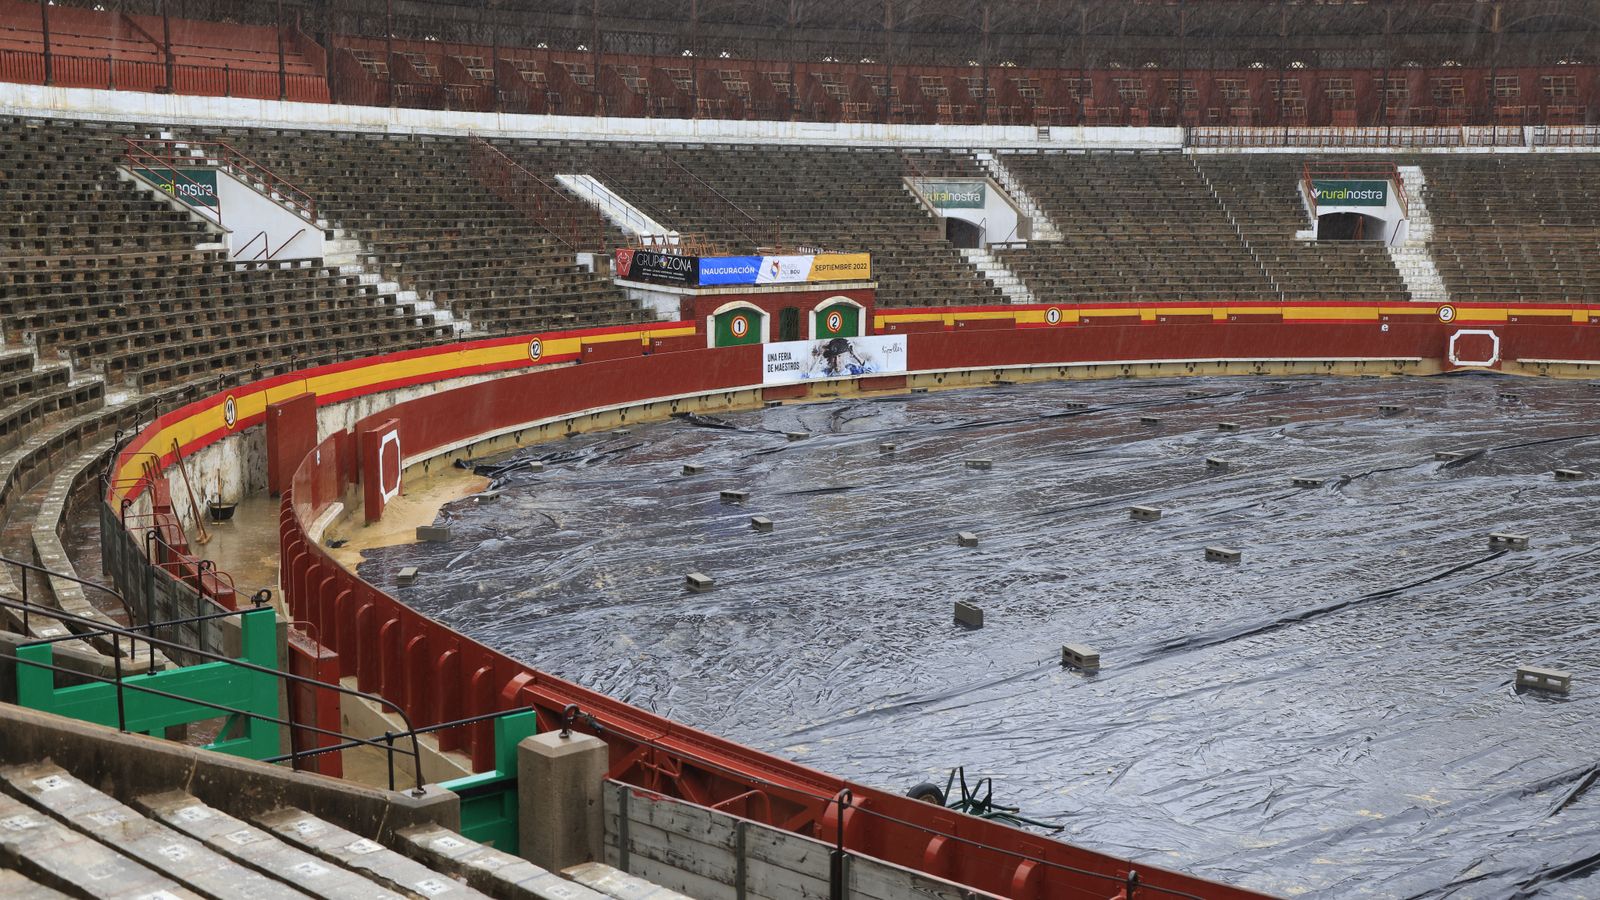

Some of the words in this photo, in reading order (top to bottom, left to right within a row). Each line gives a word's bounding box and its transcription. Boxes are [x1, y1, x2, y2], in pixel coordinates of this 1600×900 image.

[1321, 188, 1383, 200] ruralnostra
[701, 265, 755, 275] INAUGURACIÓN
[815, 264, 852, 272] SEPTIEMBRE
[1442, 309, 1449, 318] 2
[832, 317, 838, 328] 2
[532, 343, 539, 356] 12
[767, 353, 777, 363] UNA
[778, 352, 792, 361] FERIA
[767, 364, 774, 373] DE
[774, 361, 800, 371] MAESTROS
